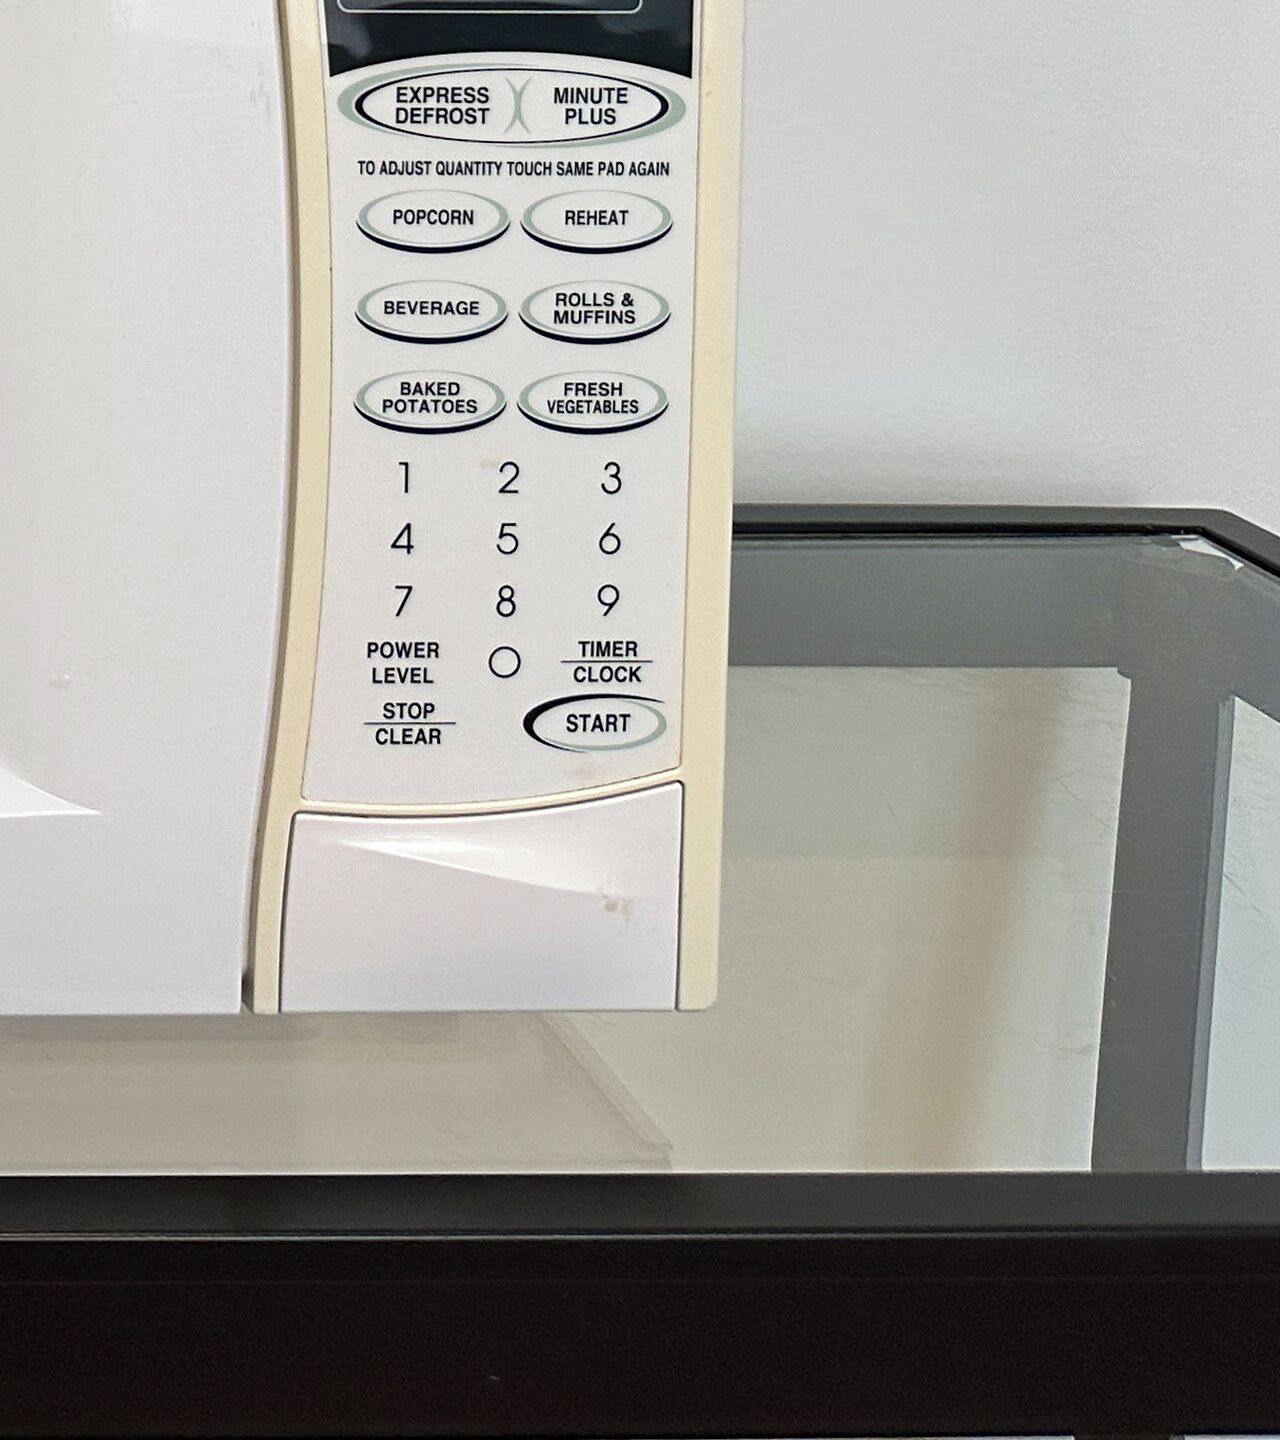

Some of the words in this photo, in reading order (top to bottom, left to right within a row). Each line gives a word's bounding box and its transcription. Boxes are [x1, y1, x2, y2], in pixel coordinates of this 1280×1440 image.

[395, 87, 490, 104] EXPRESS
[554, 87, 628, 104] MINUTE
[395, 108, 490, 125] DEFROST
[565, 108, 616, 125] PLUS
[358, 161, 376, 175] TO
[379, 161, 432, 176] ADJUST
[435, 161, 502, 177] QUANTITY
[508, 161, 552, 176] TOUCH
[556, 161, 593, 176] SAME
[598, 161, 625, 176] PAD
[628, 161, 670, 176] AGAIN
[393, 210, 474, 225] POPCORN
[565, 210, 629, 226] REHEAT
[384, 301, 480, 316] BEVERAGE
[555, 293, 615, 307] ROLLS
[622, 293, 634, 307] &
[553, 310, 636, 324] MUFFINS
[400, 382, 460, 396] BAKED
[563, 383, 623, 397] FRESH
[382, 399, 478, 414] POTATOES
[547, 400, 639, 414] VEGETABLES
[398, 461, 409, 494] 1
[498, 461, 520, 494] 2
[601, 461, 622, 495] 3
[390, 523, 414, 555] 4
[496, 523, 519, 555] 5
[599, 523, 621, 555] 6
[395, 585, 413, 617] 7
[496, 585, 516, 618] 8
[598, 584, 620, 617] 9
[367, 642, 440, 658] POWER
[578, 641, 638, 657] TIMER
[372, 668, 434, 684] LEVEL
[573, 666, 642, 683] CLOCK
[382, 703, 435, 719] STOP
[566, 714, 631, 733] START
[375, 728, 441, 745] CLEAR
